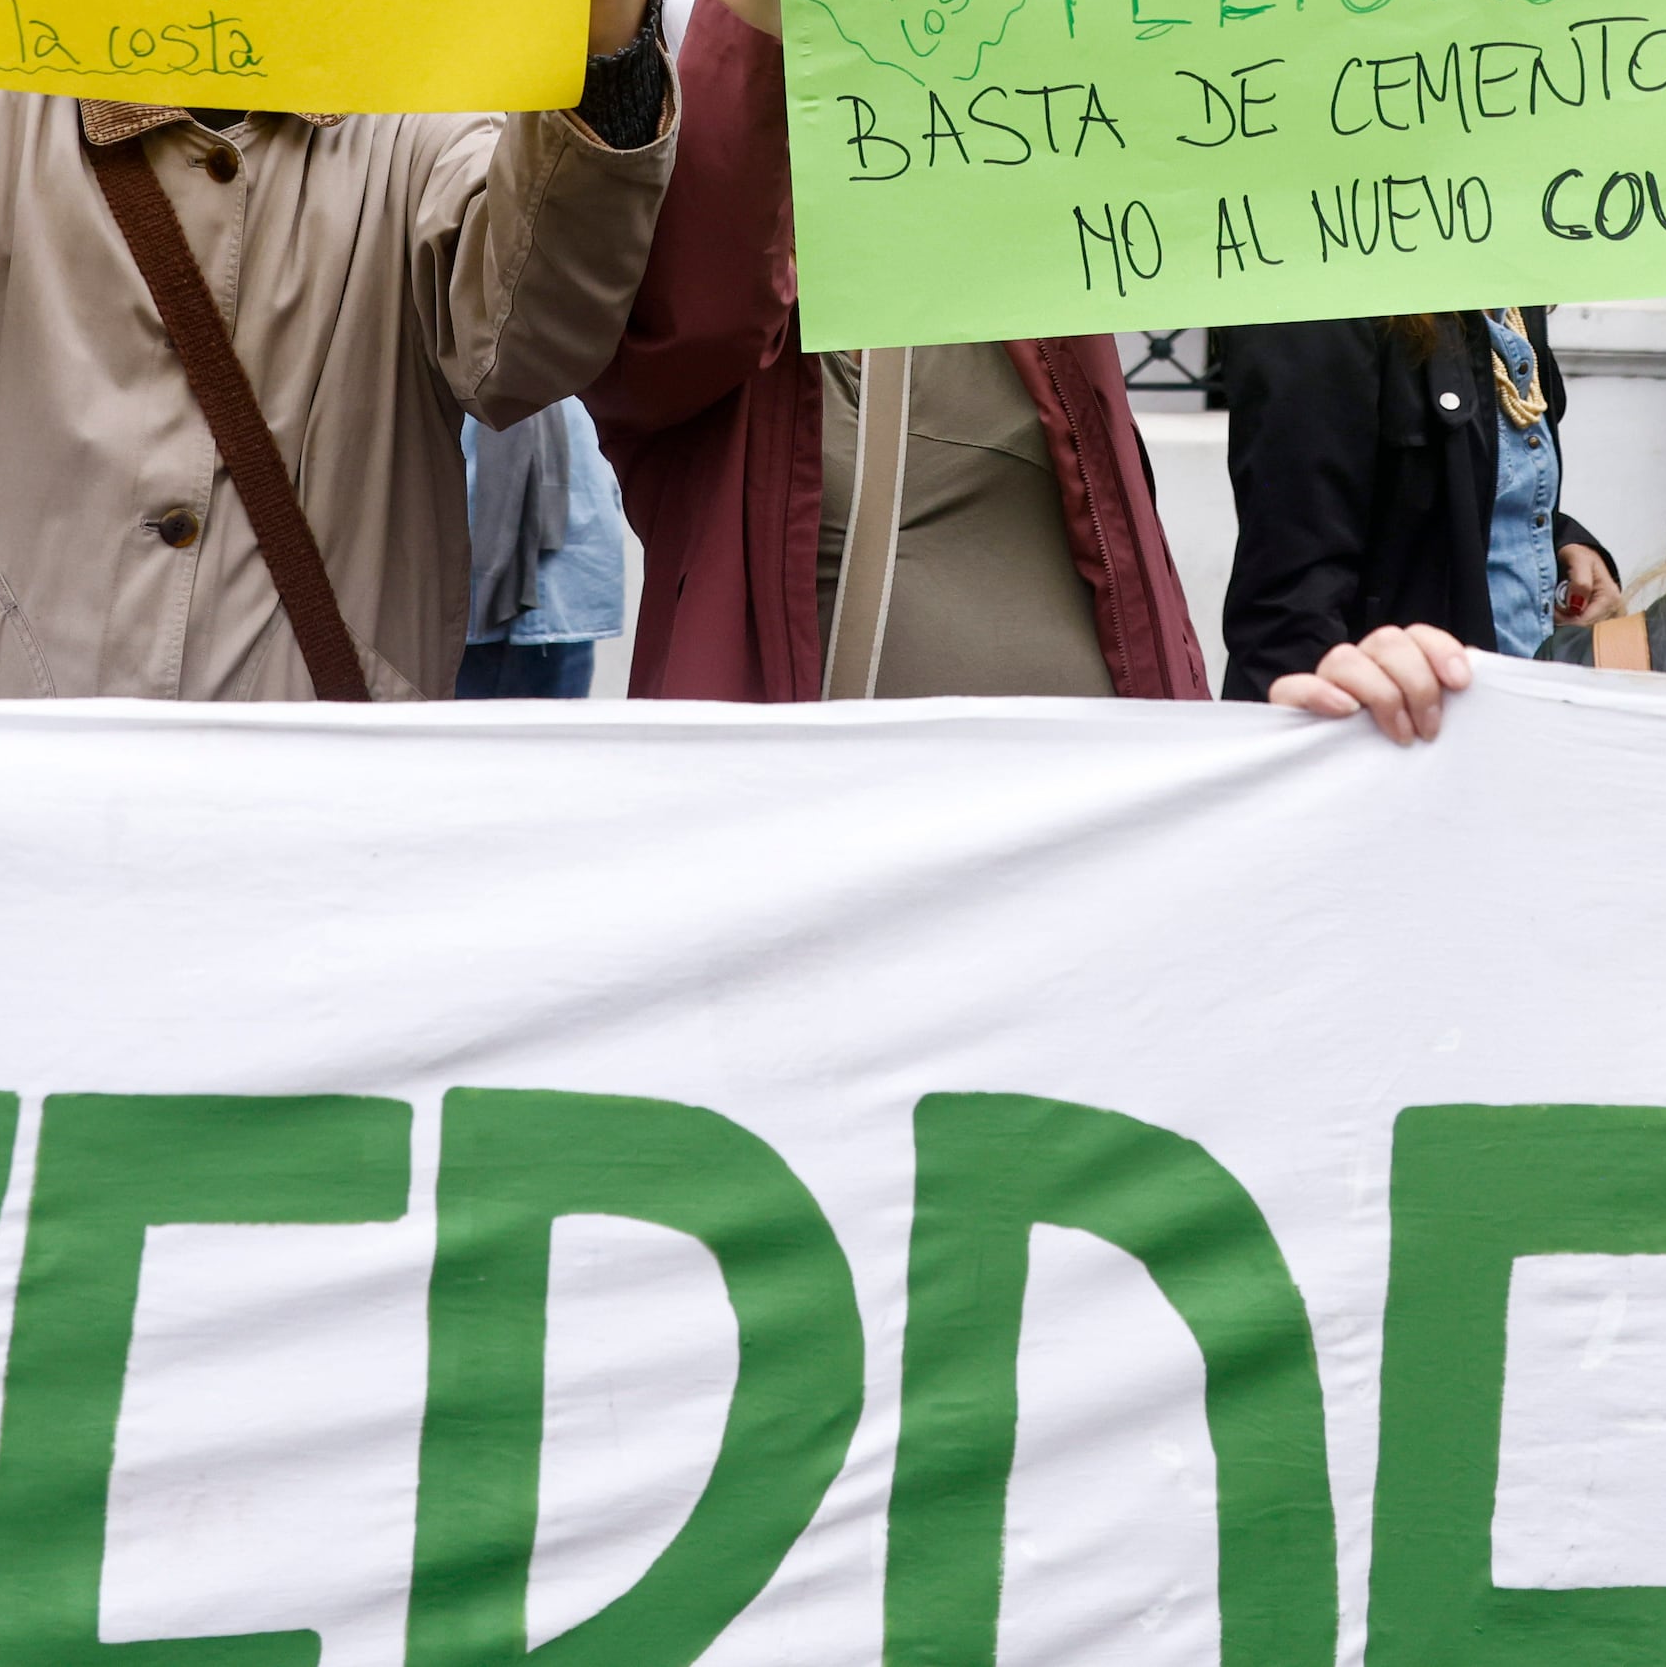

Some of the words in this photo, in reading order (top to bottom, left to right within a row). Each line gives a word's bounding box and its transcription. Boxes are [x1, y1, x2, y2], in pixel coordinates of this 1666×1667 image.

[110, 10, 262, 73] costa
[836, 83, 1125, 181] BASTA
[1175, 59, 1285, 147] DE
[1073, 200, 1162, 297] NO
[1216, 194, 1284, 279] AL
[1311, 174, 1492, 263] NUEVO
